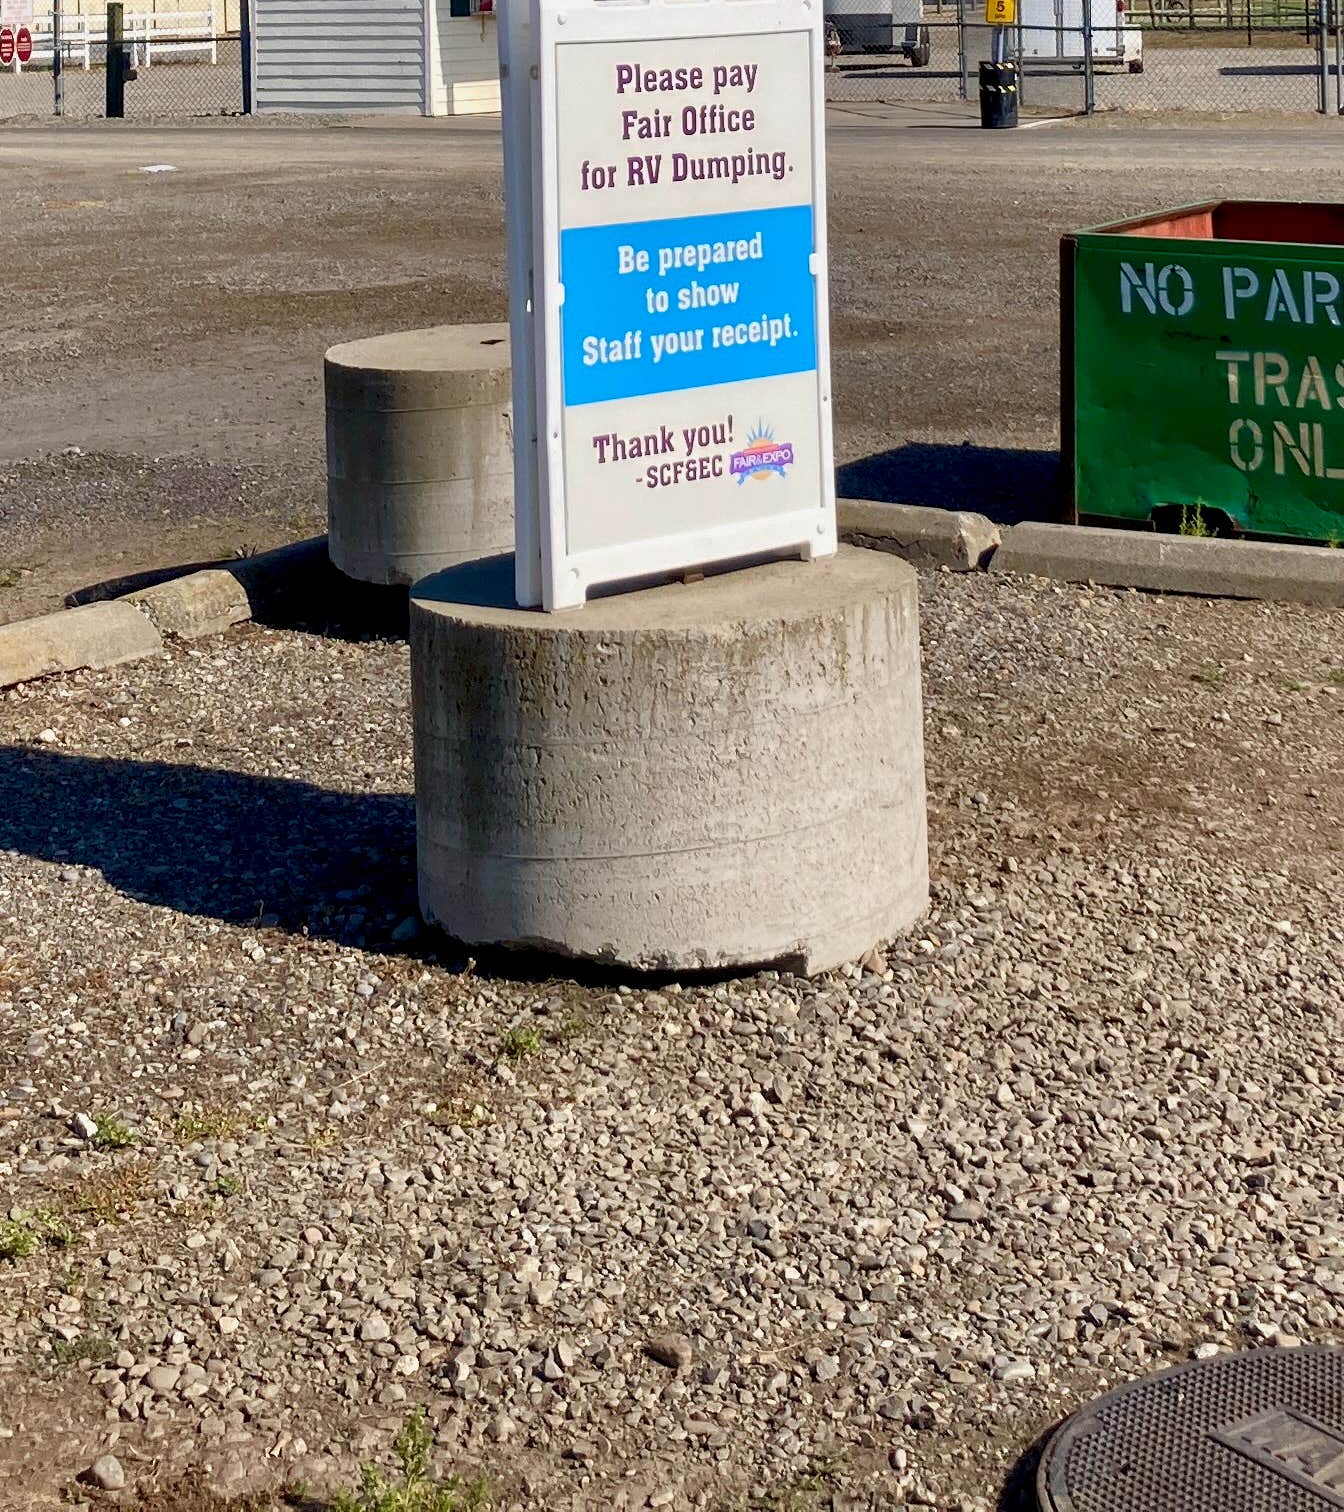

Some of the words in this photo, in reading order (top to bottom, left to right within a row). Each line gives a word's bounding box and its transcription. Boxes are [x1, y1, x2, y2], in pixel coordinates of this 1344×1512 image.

[996, 1, 1005, 12] 5
[616, 64, 703, 94] Please
[713, 63, 758, 95] pay
[622, 108, 672, 140] Fair
[682, 104, 755, 136] Office
[581, 160, 617, 191] for
[627, 154, 662, 186] RV
[672, 147, 794, 184] Dumping.
[618, 245, 649, 274] Be
[659, 231, 763, 277] prepared
[646, 288, 669, 314] to
[677, 281, 739, 312] show
[1119, 262, 1195, 316] NO
[582, 330, 642, 367] Staff
[651, 328, 704, 364] your
[712, 313, 799, 348] receipt.
[592, 426, 675, 464] Thank
[683, 414, 734, 456] you!
[734, 454, 756, 470] FAIR
[763, 449, 791, 464] EXPO
